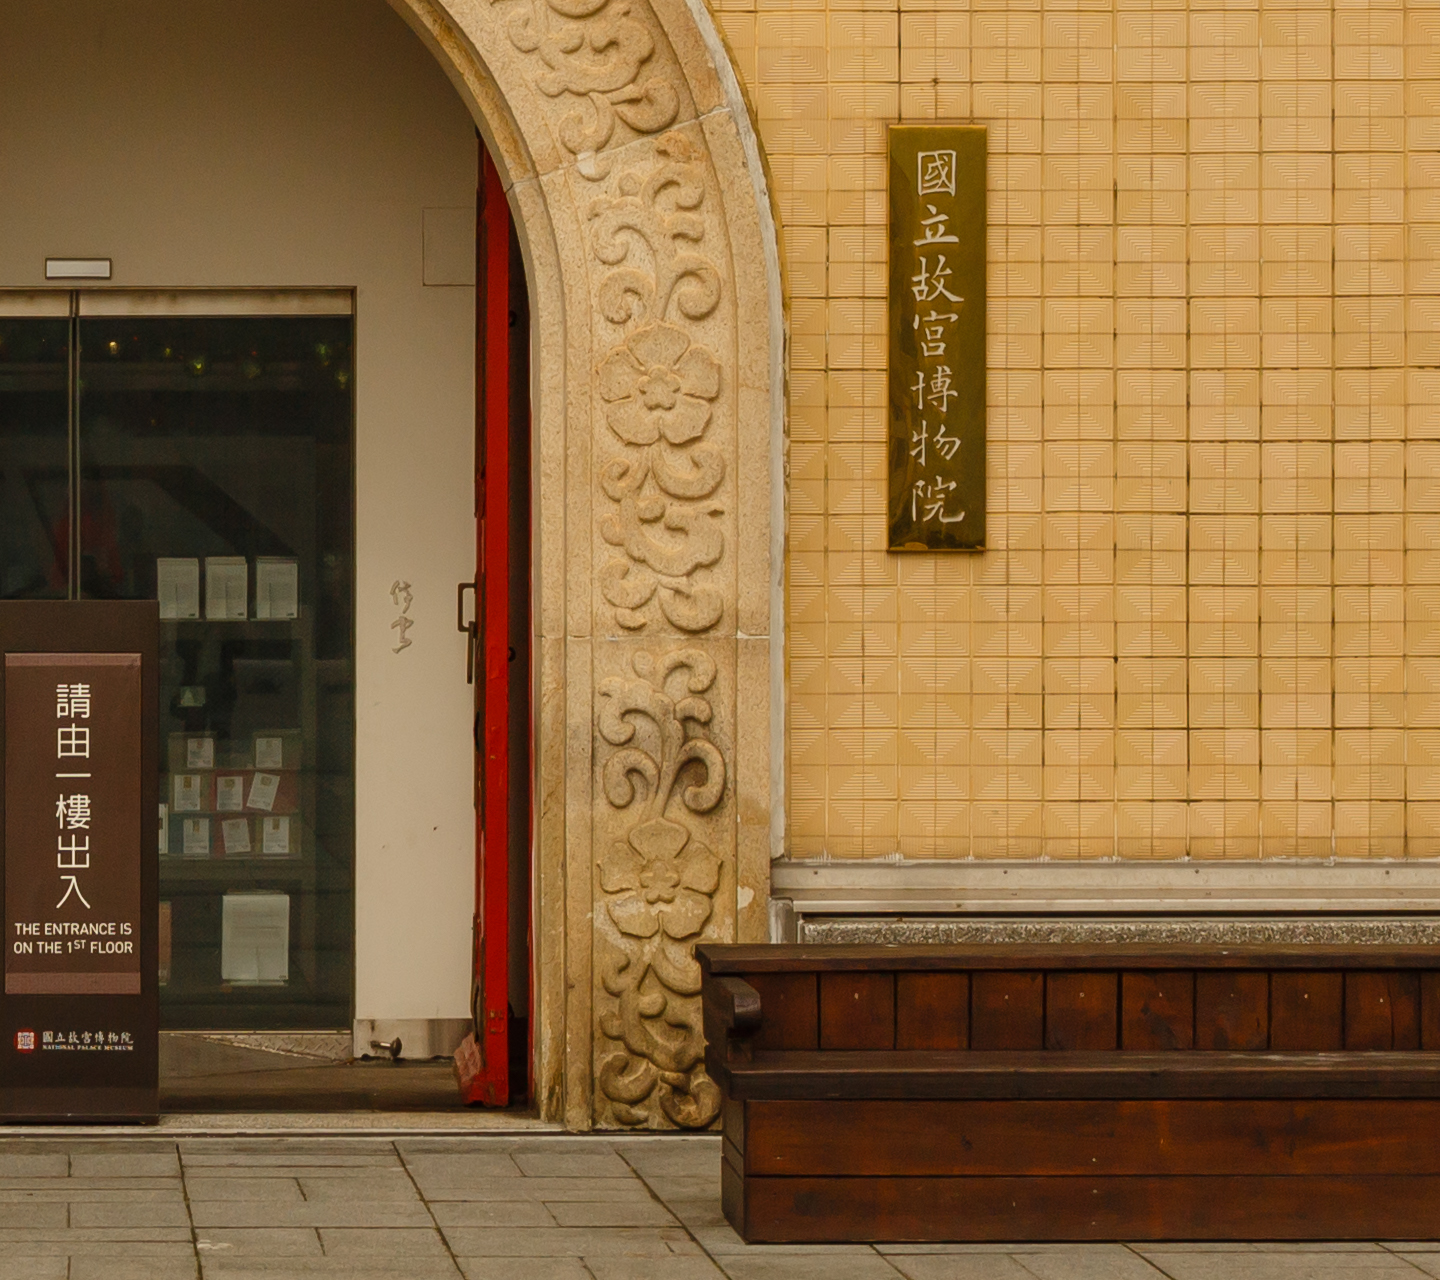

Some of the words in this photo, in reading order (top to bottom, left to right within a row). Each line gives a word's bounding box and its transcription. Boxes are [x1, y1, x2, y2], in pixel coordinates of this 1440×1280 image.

[908, 149, 966, 524] 國立故宮博物院
[55, 682, 91, 909] 請由一樓出入
[14, 922, 40, 935] THE
[44, 922, 116, 935] ENTRANCE
[120, 922, 133, 935] IS
[13, 941, 33, 954] ON
[37, 941, 62, 954] THE
[67, 939, 86, 954] 1ST
[90, 941, 133, 954] FLOOR
[42, 1030, 134, 1044] 國立故宮博物院
